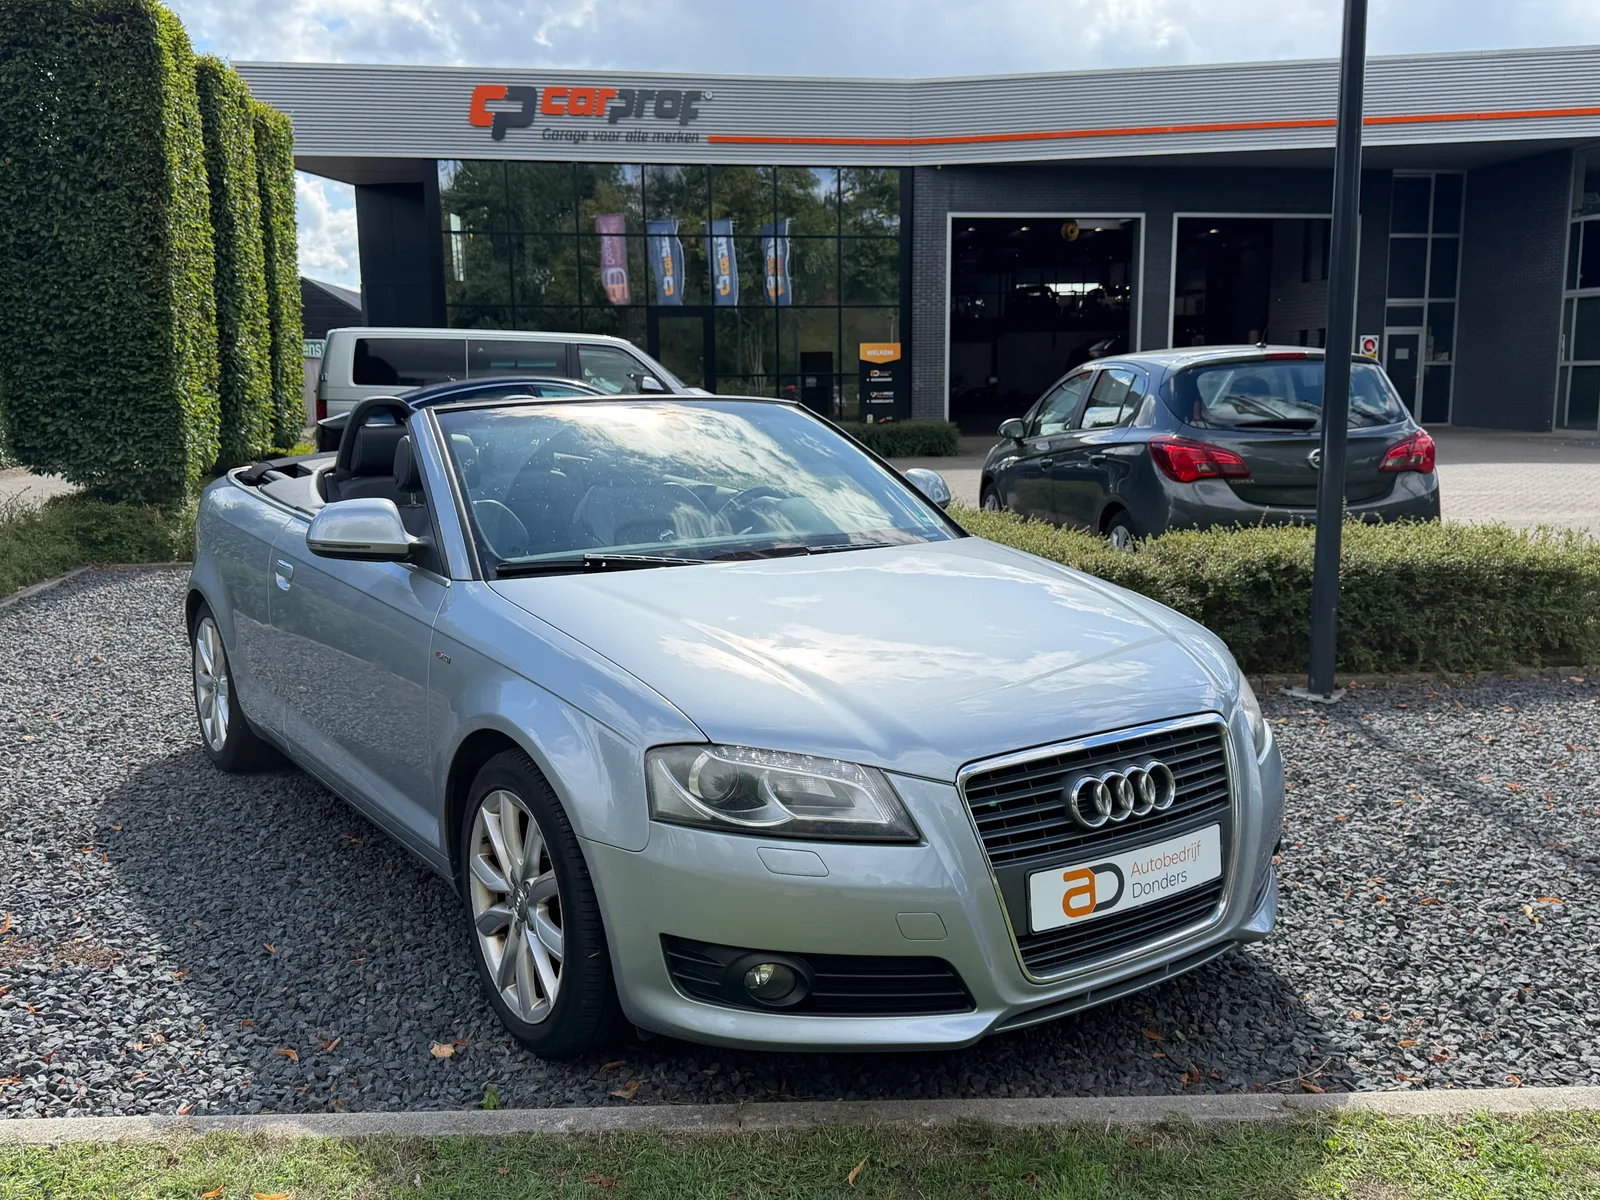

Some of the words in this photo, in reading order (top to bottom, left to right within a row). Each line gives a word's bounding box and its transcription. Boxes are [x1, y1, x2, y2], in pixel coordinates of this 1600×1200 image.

[540, 86, 701, 126] carprof
[542, 128, 589, 144] Garage
[593, 131, 622, 142] voor
[626, 128, 649, 142] alle
[652, 130, 699, 143] merken
[1130, 840, 1202, 878] Autobedrijf
[1132, 870, 1188, 898] Donders
